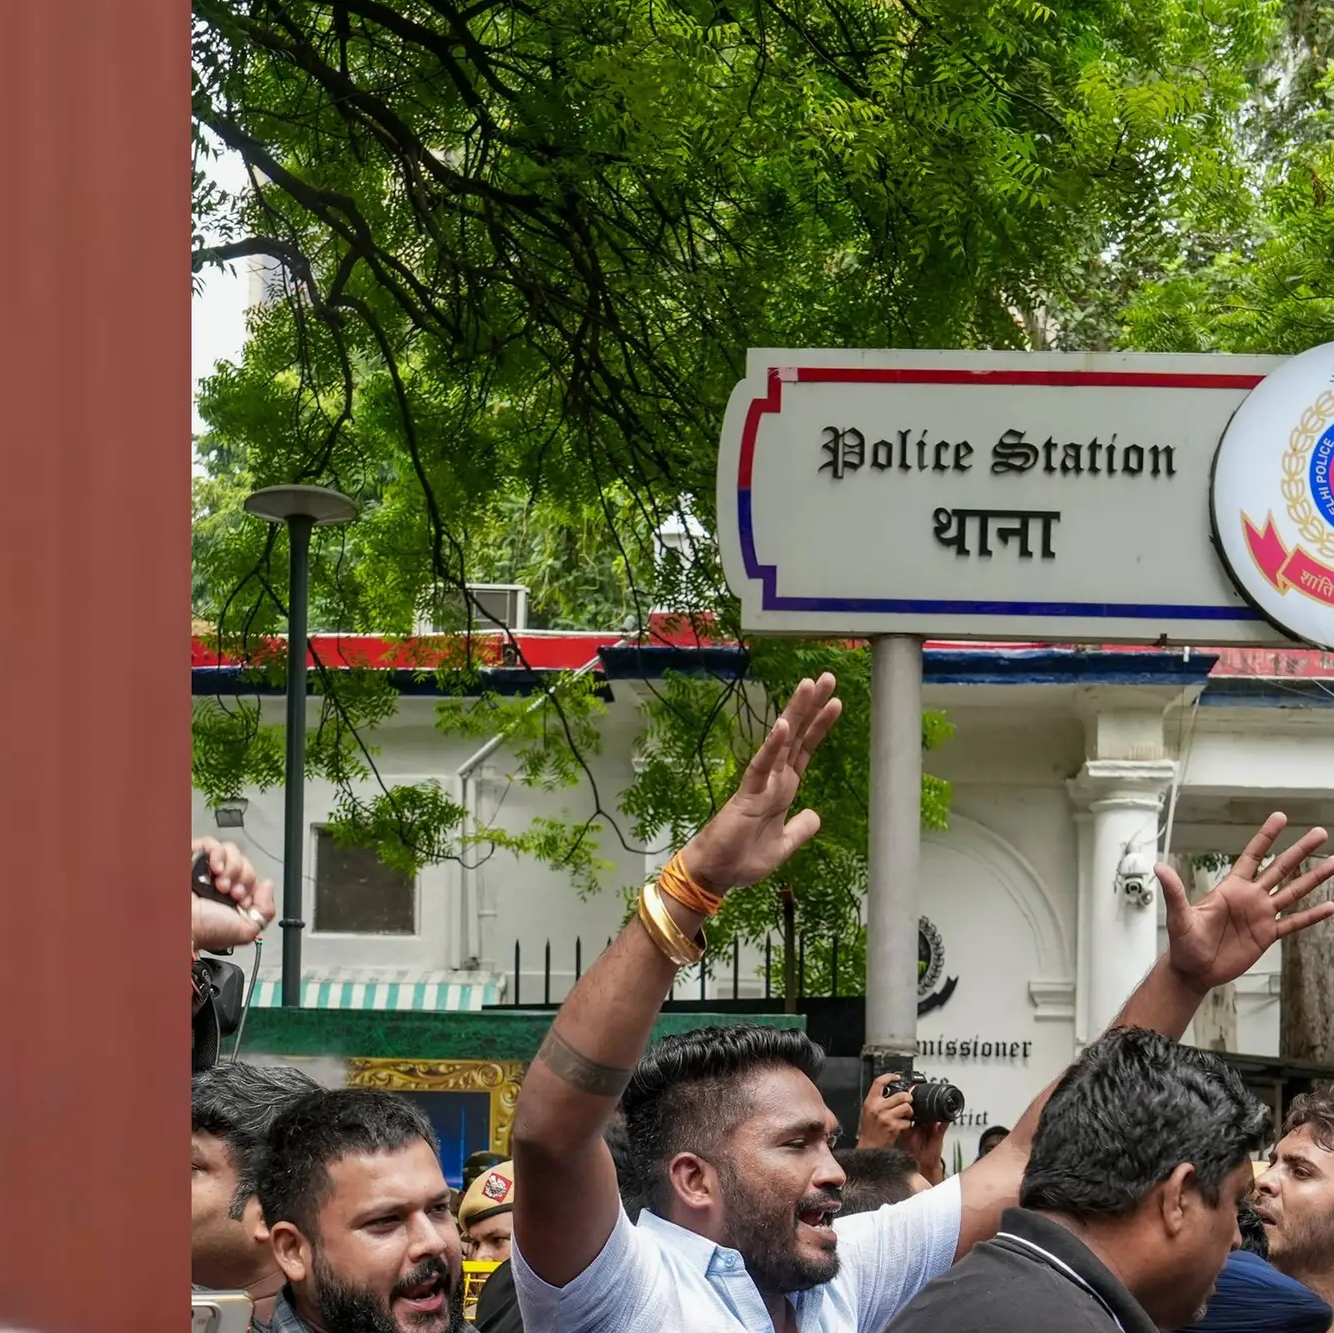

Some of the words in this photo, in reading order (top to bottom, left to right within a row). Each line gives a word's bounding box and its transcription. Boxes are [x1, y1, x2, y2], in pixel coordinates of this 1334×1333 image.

[818, 426, 974, 479] Police
[990, 429, 1177, 476] Station
[1315, 438, 1334, 484] POLICE
[933, 507, 1061, 559] थाना
[917, 1034, 1032, 1058] missioner
